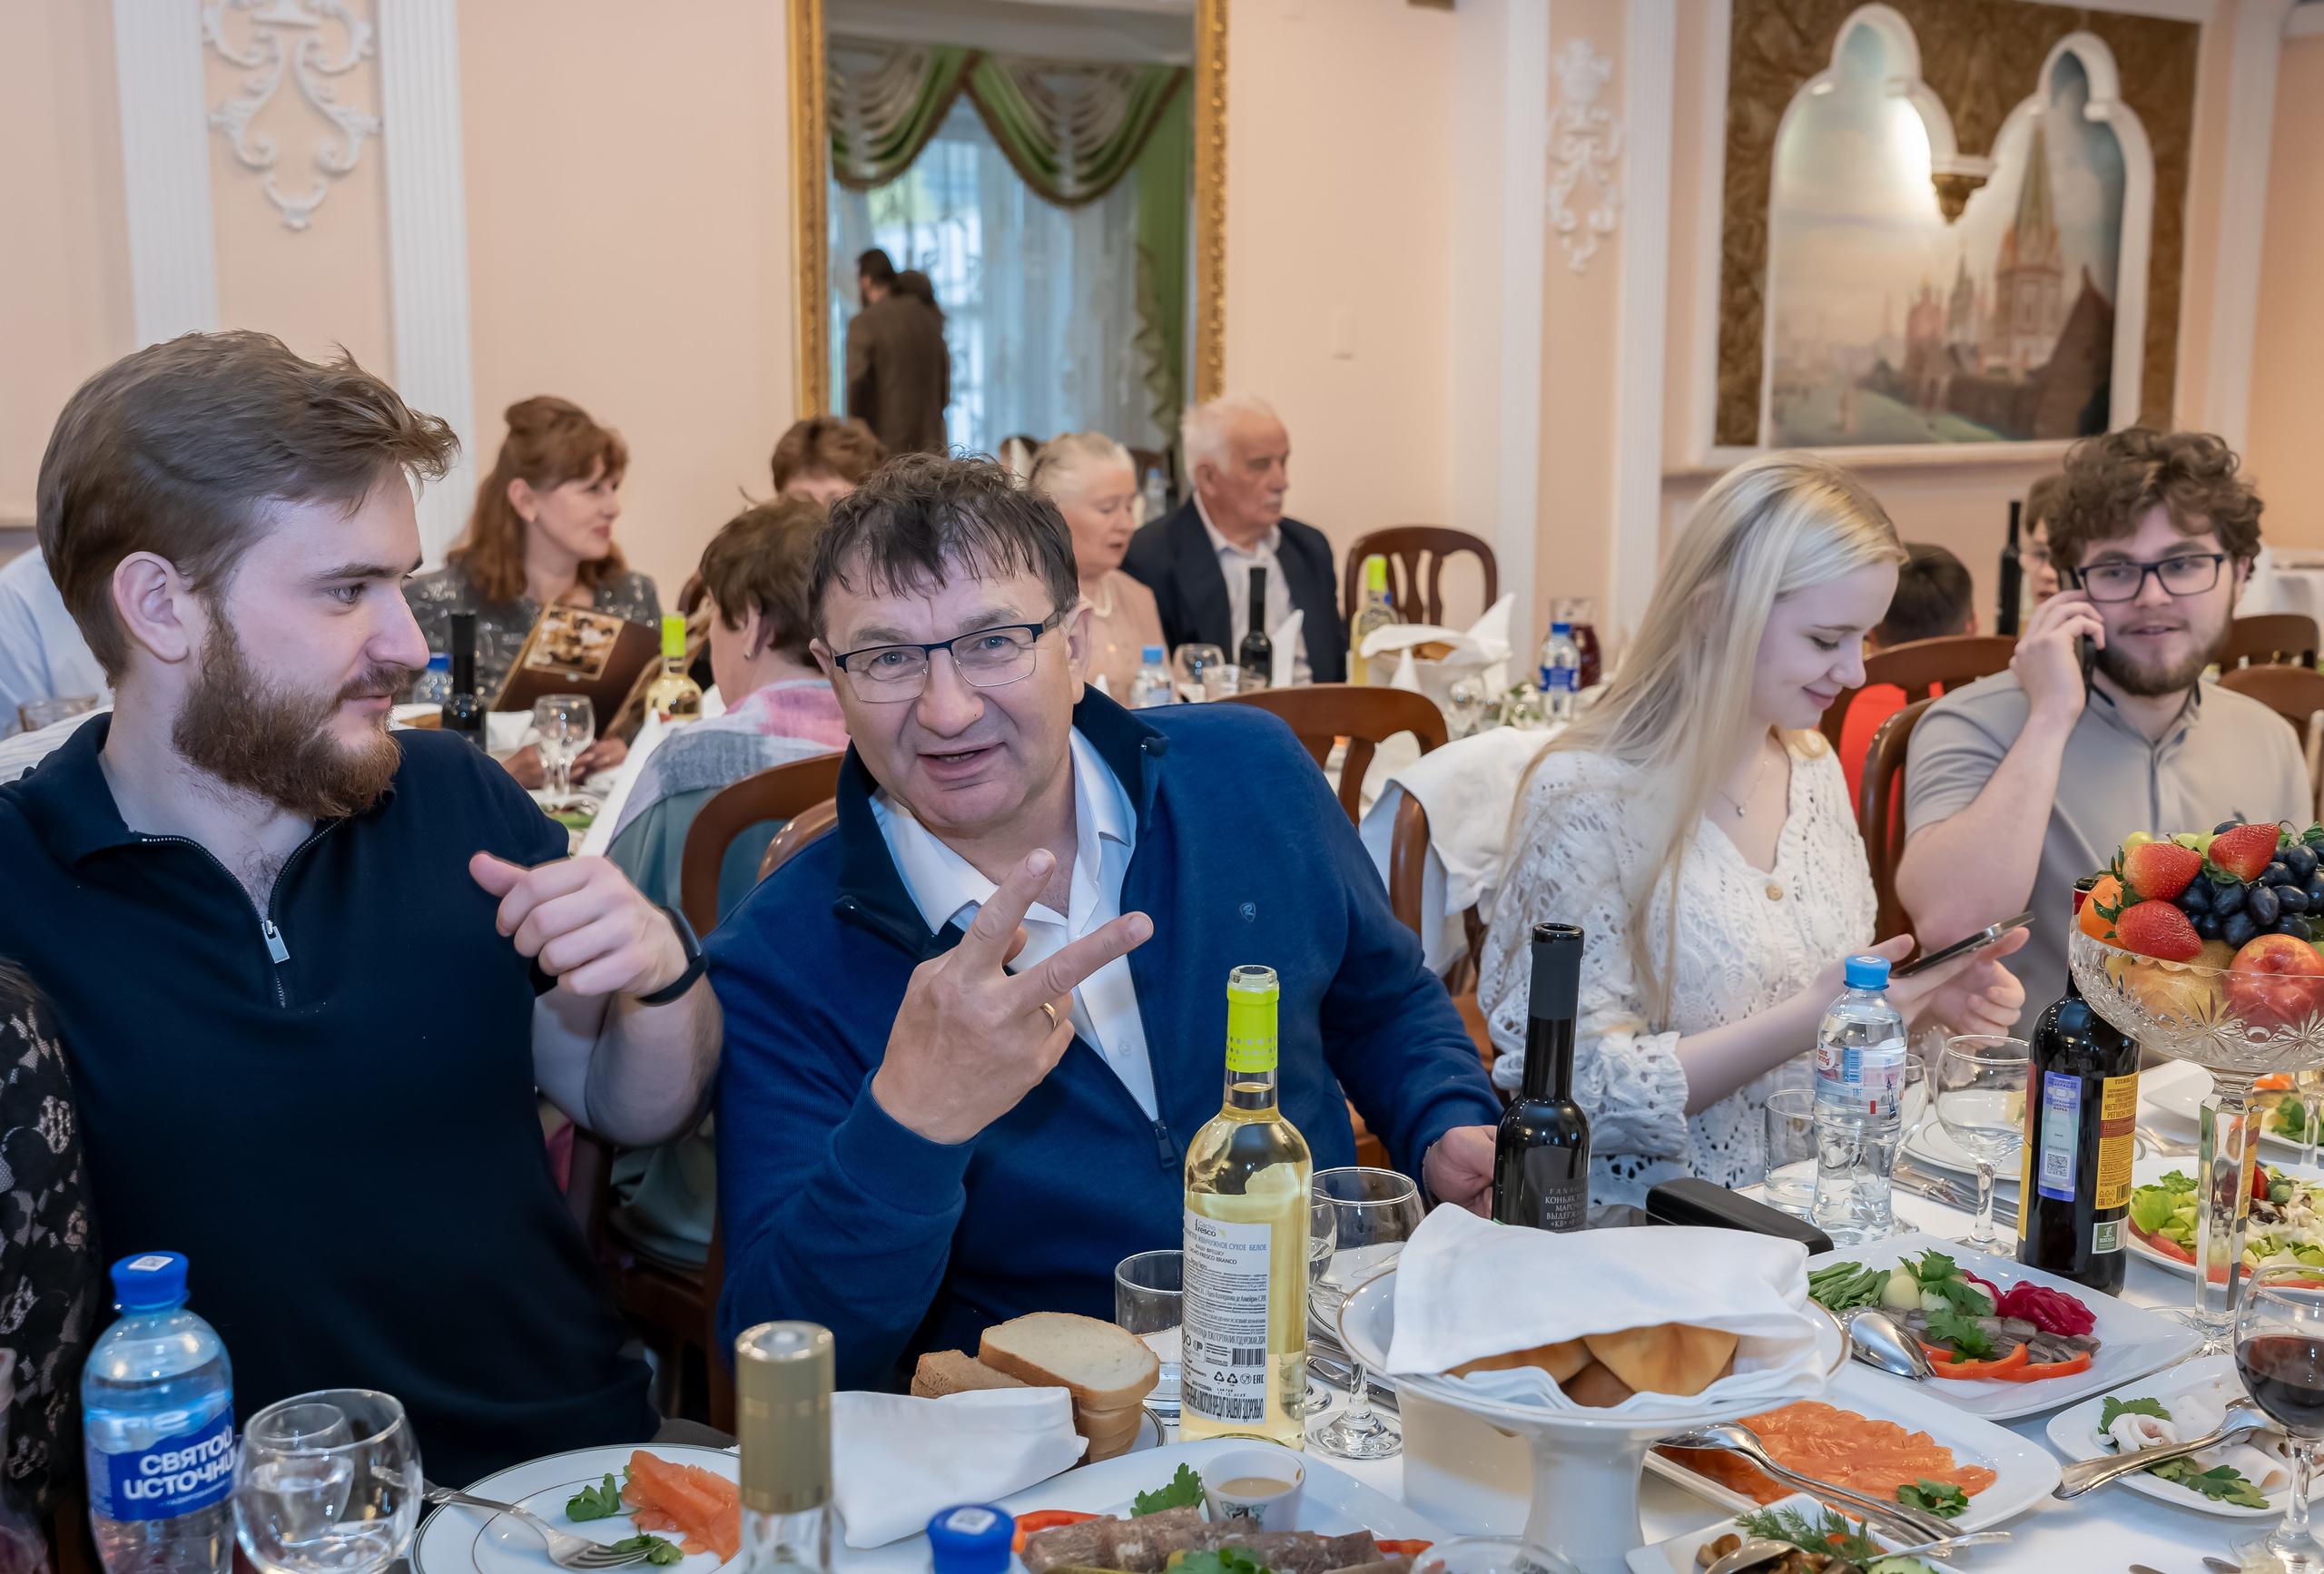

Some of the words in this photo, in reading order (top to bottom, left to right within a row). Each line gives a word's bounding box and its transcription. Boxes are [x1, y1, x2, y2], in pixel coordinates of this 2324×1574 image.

[1545, 1195, 1575, 1205] КОНЬЯК
[1197, 1235, 1228, 1249] ЖЕМЧУЖНОЕ
[1229, 1243, 1246, 1251] СУХОЕ
[1199, 1251, 1216, 1262] FRESCO
[139, 1423, 233, 1476] СВЯТОЙ
[123, 1447, 237, 1500] ИСТОЧНИ
